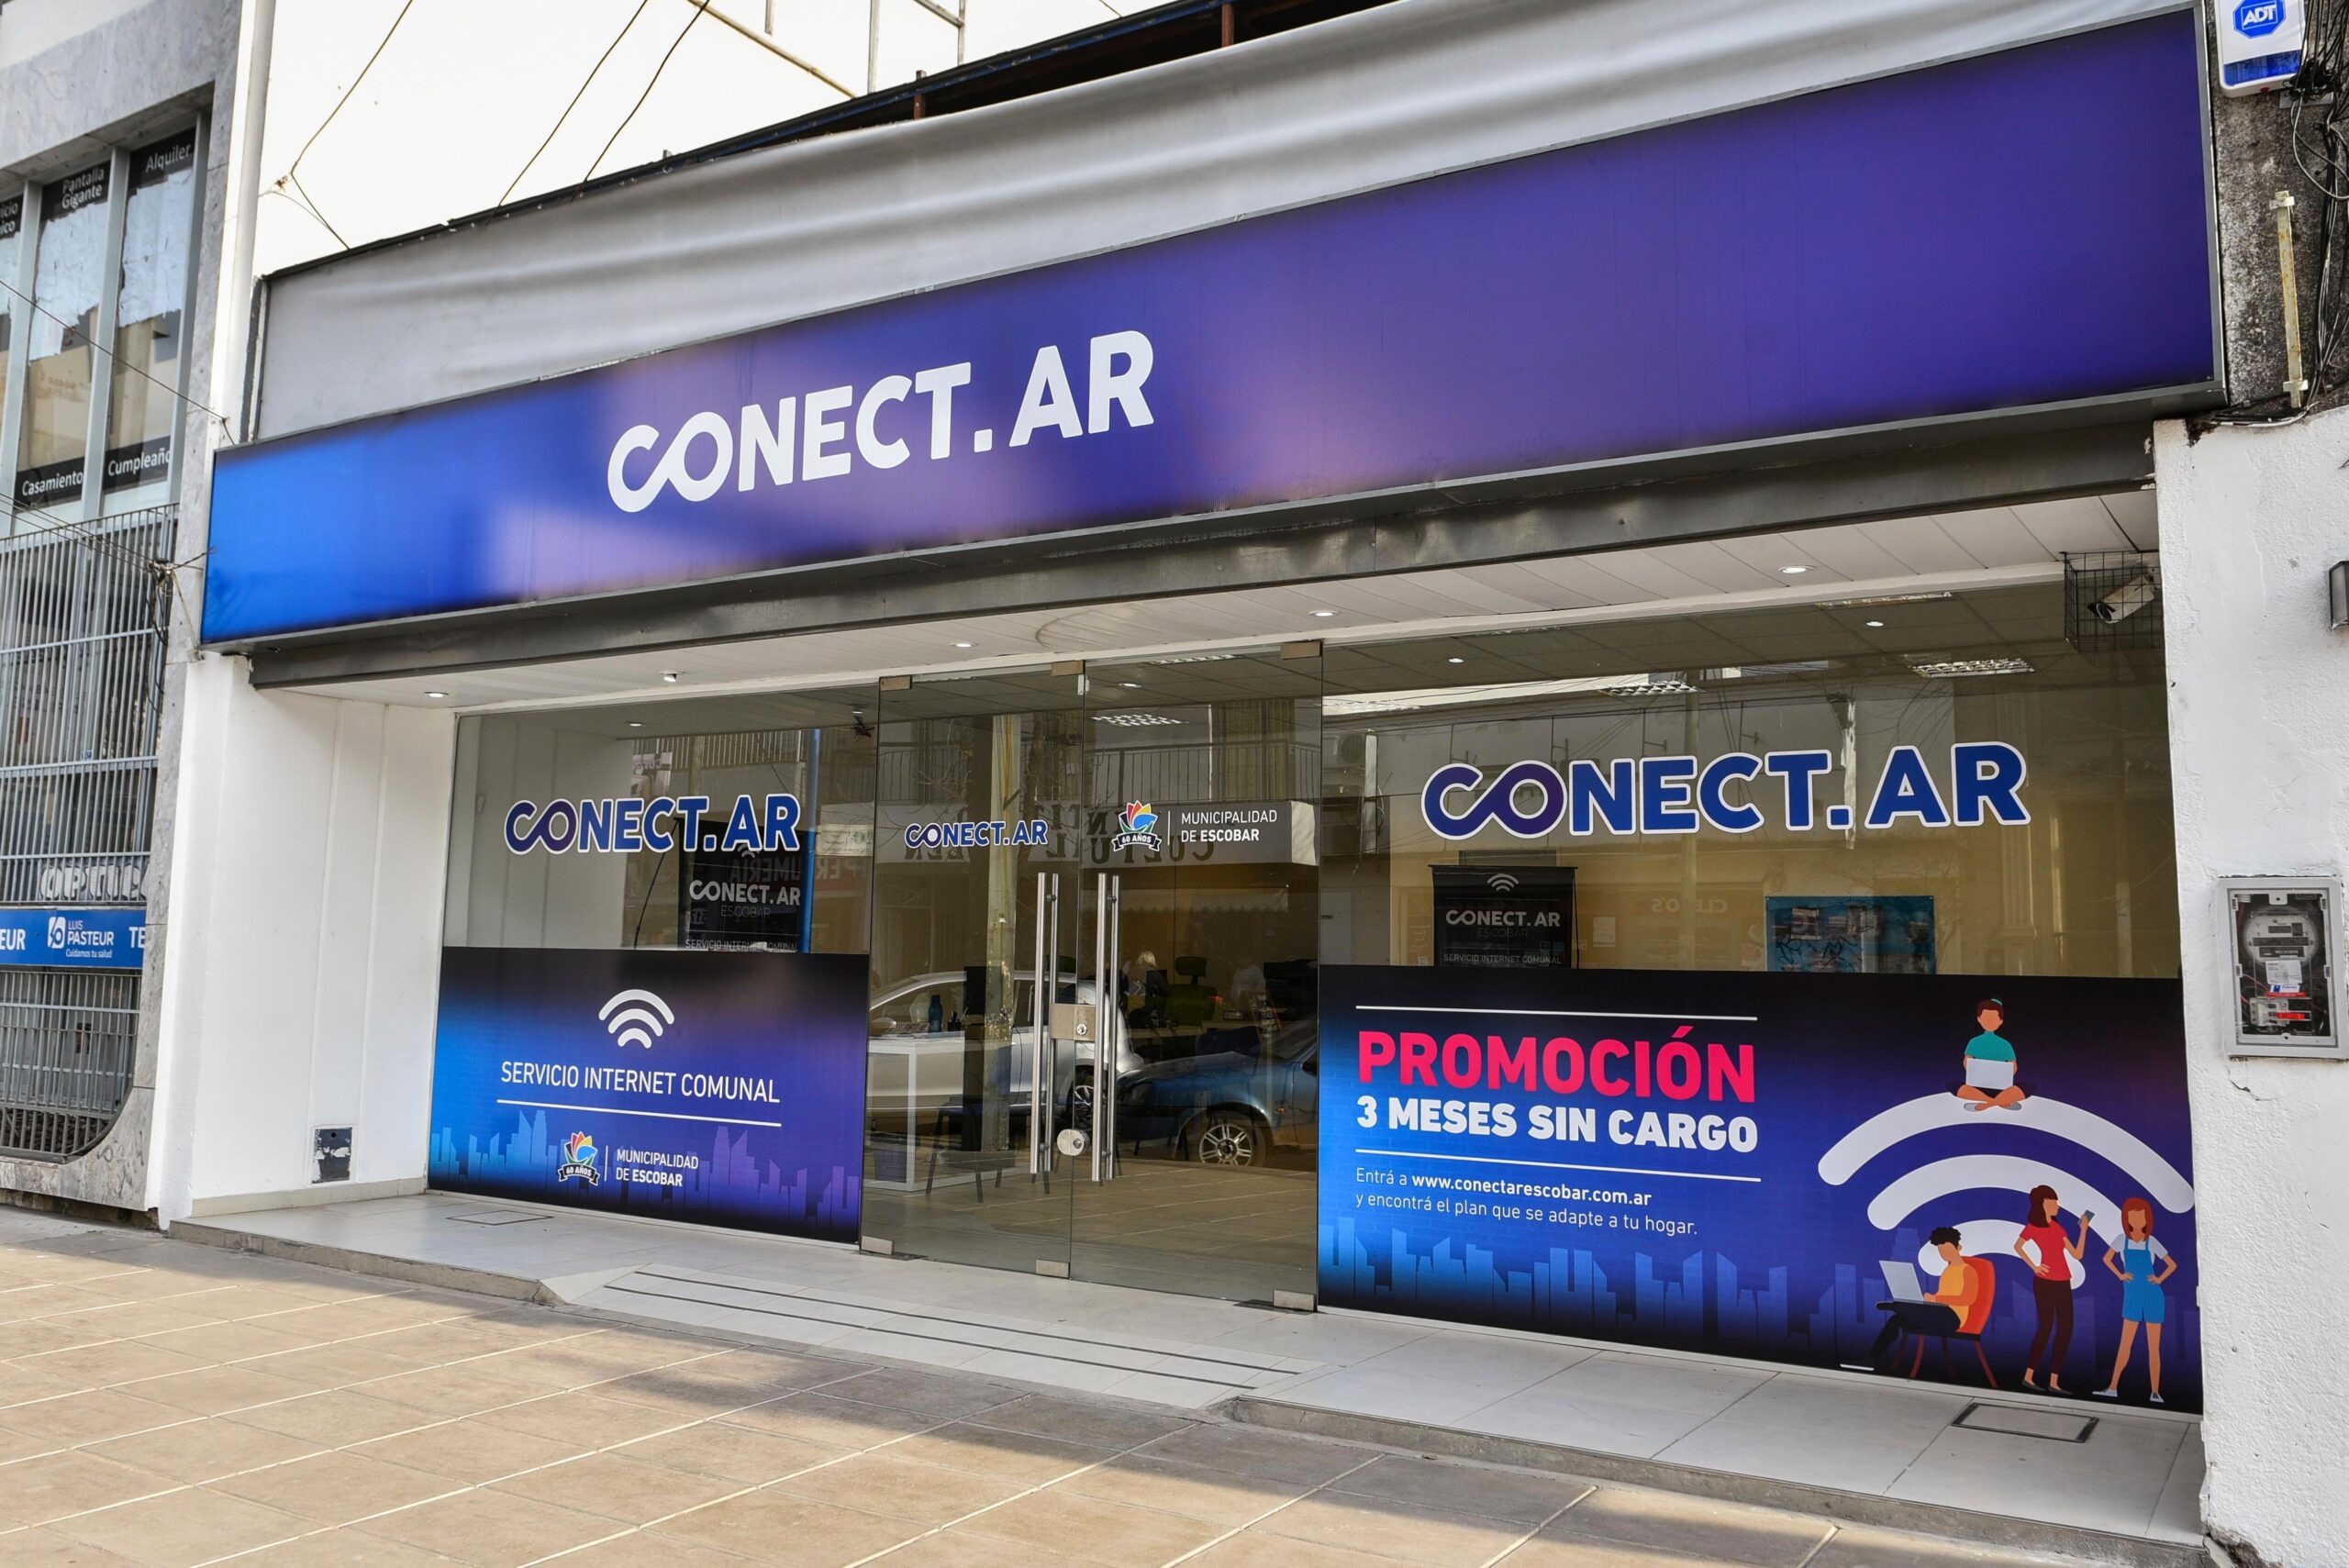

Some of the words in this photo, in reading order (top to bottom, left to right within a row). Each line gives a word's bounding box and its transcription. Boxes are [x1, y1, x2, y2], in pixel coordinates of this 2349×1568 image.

[2243, 4, 2277, 27] ADT
[145, 143, 191, 172] Alquiler
[62, 166, 105, 195] Pantalla
[61, 184, 103, 209] Gigante
[607, 330, 1154, 512] CONECT.AR
[22, 470, 83, 495] Casamiento
[1420, 741, 2032, 840] CONECT.AR
[504, 794, 800, 854] CONECT.AR
[1181, 809, 1278, 826] MUNICIPALIDAD
[905, 819, 1048, 849] CONECT.AR
[1121, 835, 1130, 843] 60
[1131, 833, 1152, 843] AÑOS
[1181, 829, 1197, 842] DE
[1200, 828, 1259, 842] ESCOBAR
[689, 880, 801, 907] CONECT.AR
[720, 905, 771, 917] ESCOBAR
[1445, 909, 1560, 926] CONECT.AR
[68, 920, 83, 930] LUIS
[1477, 928, 1527, 937] ESCOBAR
[67, 931, 115, 946] PASTEUR
[685, 939, 721, 949] SERVICIO
[98, 949, 112, 958] salud
[1443, 953, 1479, 962] SERVICIO
[1481, 954, 1520, 963] INTERNET
[1522, 955, 1562, 964] COMUNAL
[1358, 1026, 1755, 1103] PROMOCIÓN
[500, 1061, 580, 1088] SERVICIO
[584, 1066, 677, 1095] INTERNET
[681, 1073, 781, 1103] COMUNAL
[1357, 1095, 1377, 1129] 3
[1388, 1097, 1518, 1138] MESES
[1528, 1106, 1597, 1143] SIN
[1609, 1109, 1758, 1152] CARGO
[565, 1166, 573, 1174] 60
[574, 1165, 592, 1176] AÑOS
[617, 1149, 699, 1170] MUNICIPALIDAD
[616, 1168, 629, 1182] DE
[631, 1169, 683, 1187] ESCOBAR
[1355, 1167, 1395, 1185] Entrá
[1398, 1173, 1408, 1185] a
[1411, 1173, 1652, 1207] www.conectarescobar.com.ar
[1355, 1195, 1364, 1208] y
[1367, 1193, 1431, 1212] encontrá
[1437, 1196, 1450, 1213] el
[1454, 1198, 1487, 1218] plan
[1492, 1205, 1520, 1221] que
[1525, 1207, 1543, 1222] se
[1549, 1207, 1604, 1229] adapte
[1609, 1215, 1618, 1229] a
[1623, 1214, 1640, 1230] tu
[1645, 1217, 1698, 1237] hogar.
